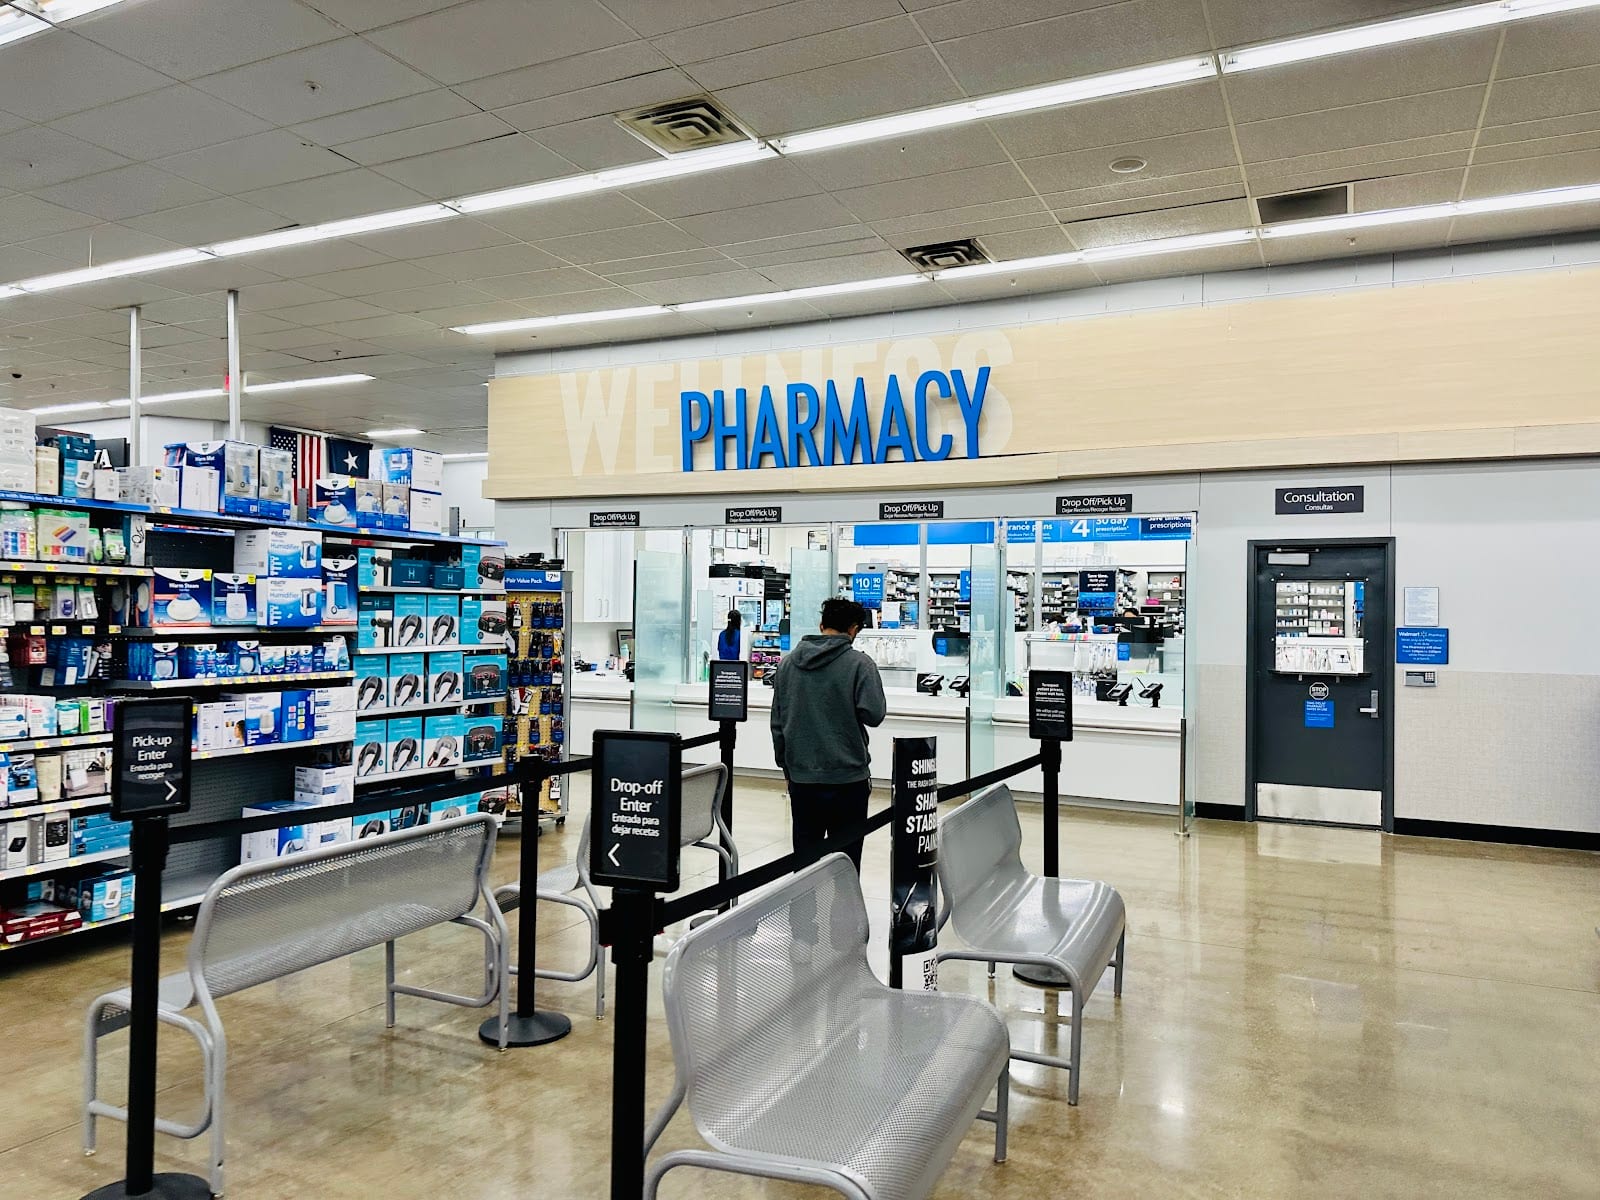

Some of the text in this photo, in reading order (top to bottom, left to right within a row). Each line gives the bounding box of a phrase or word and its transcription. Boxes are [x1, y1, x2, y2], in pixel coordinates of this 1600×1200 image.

[680, 365, 992, 473] PHARMACY
[1061, 496, 1127, 508] Drop Off/Pick Up
[1283, 490, 1355, 503] Consultation
[884, 503, 939, 514] Drop Off/Pick Up
[1304, 503, 1334, 511] Consultas
[593, 513, 607, 523] Drop
[627, 513, 636, 522] Up
[729, 510, 745, 519] Drop
[768, 508, 778, 518] Up
[1149, 520, 1192, 531] prescriptions
[855, 577, 870, 588] $10
[132, 734, 173, 748] Pick-up
[137, 750, 168, 762] Enter
[610, 777, 664, 797] Drop-off
[906, 780, 918, 789] THE
[620, 796, 653, 813] Enter
[611, 812, 660, 827] Entrada para
[611, 823, 661, 837] dejar recetas
